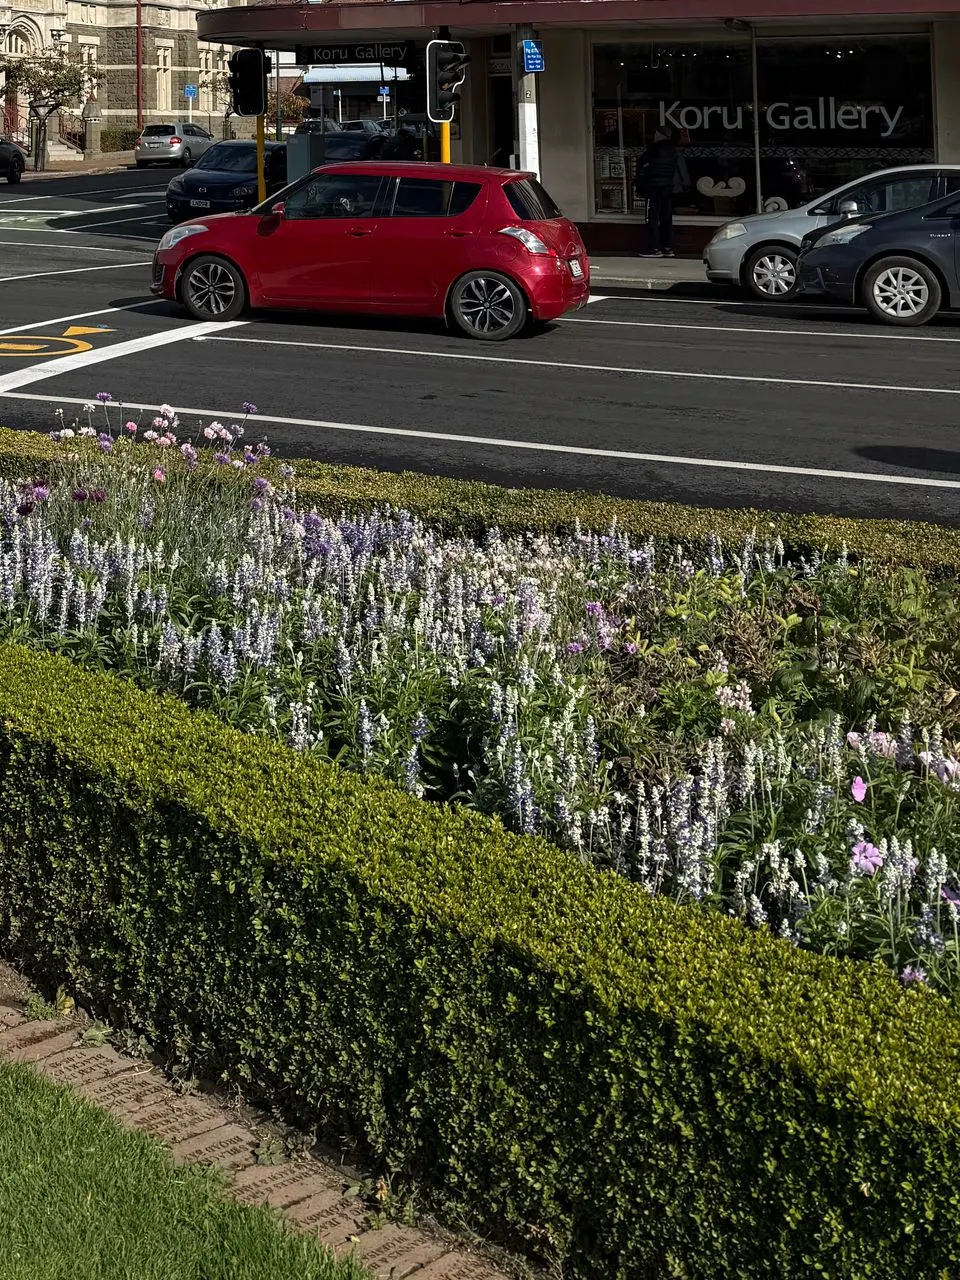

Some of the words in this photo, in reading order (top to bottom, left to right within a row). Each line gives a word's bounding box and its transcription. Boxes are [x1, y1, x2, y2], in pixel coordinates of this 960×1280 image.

[313, 48, 348, 60] Koru
[355, 44, 408, 60] Gallery
[659, 100, 743, 129] Koru
[766, 96, 904, 137] Gallery
